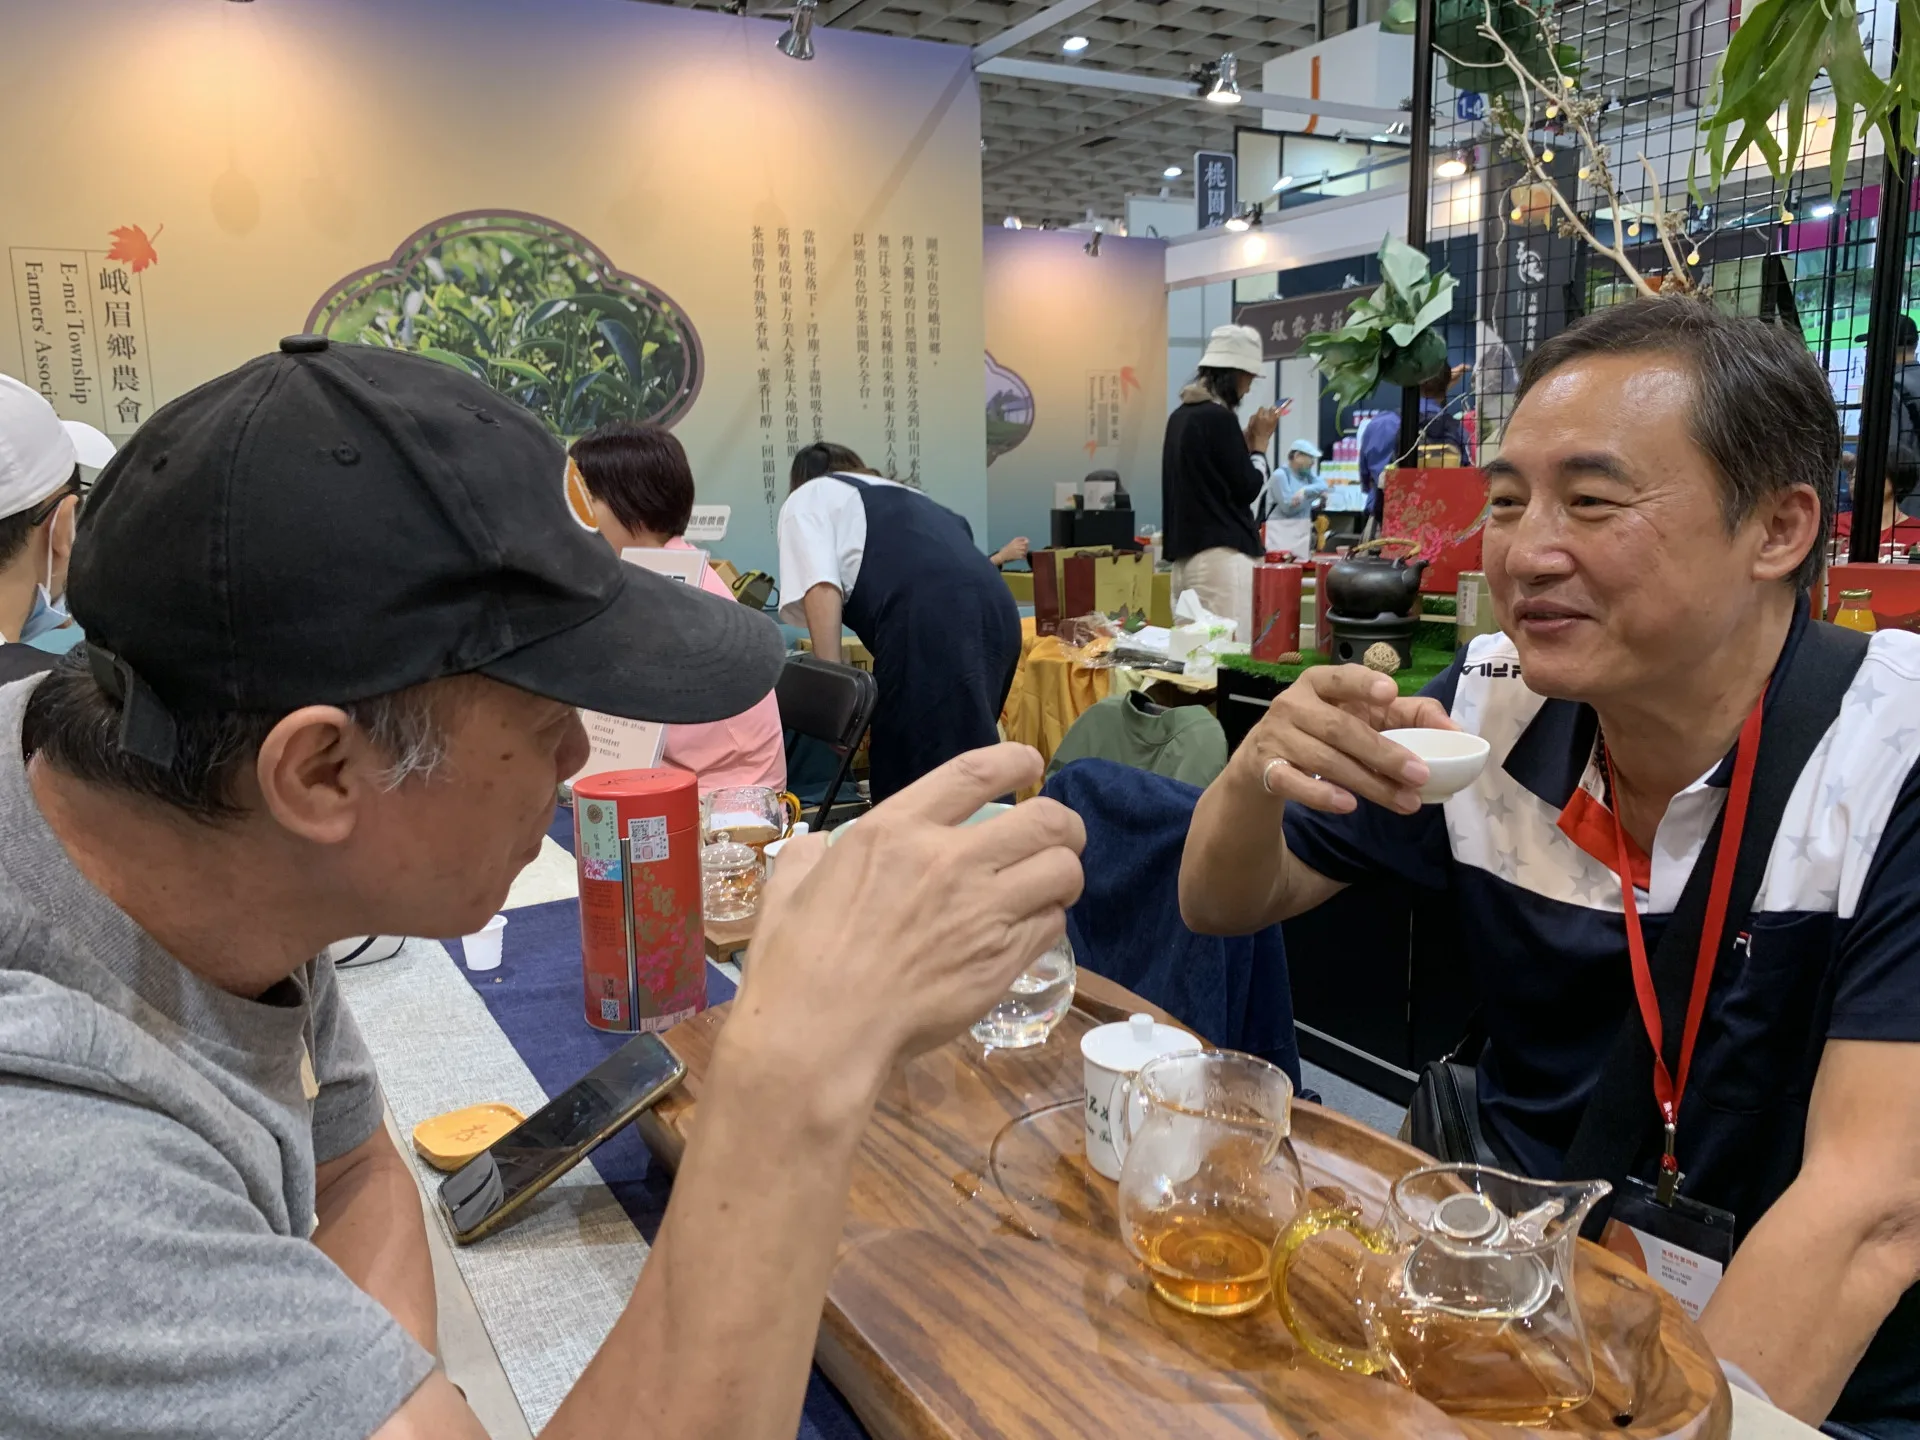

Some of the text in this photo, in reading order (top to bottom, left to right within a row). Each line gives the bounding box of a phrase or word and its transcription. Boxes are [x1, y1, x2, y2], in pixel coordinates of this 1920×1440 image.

[25, 261, 52, 336] Farmers'
[60, 262, 92, 405] E-mei Township
[99, 267, 142, 424] 峨眉鄉農會
